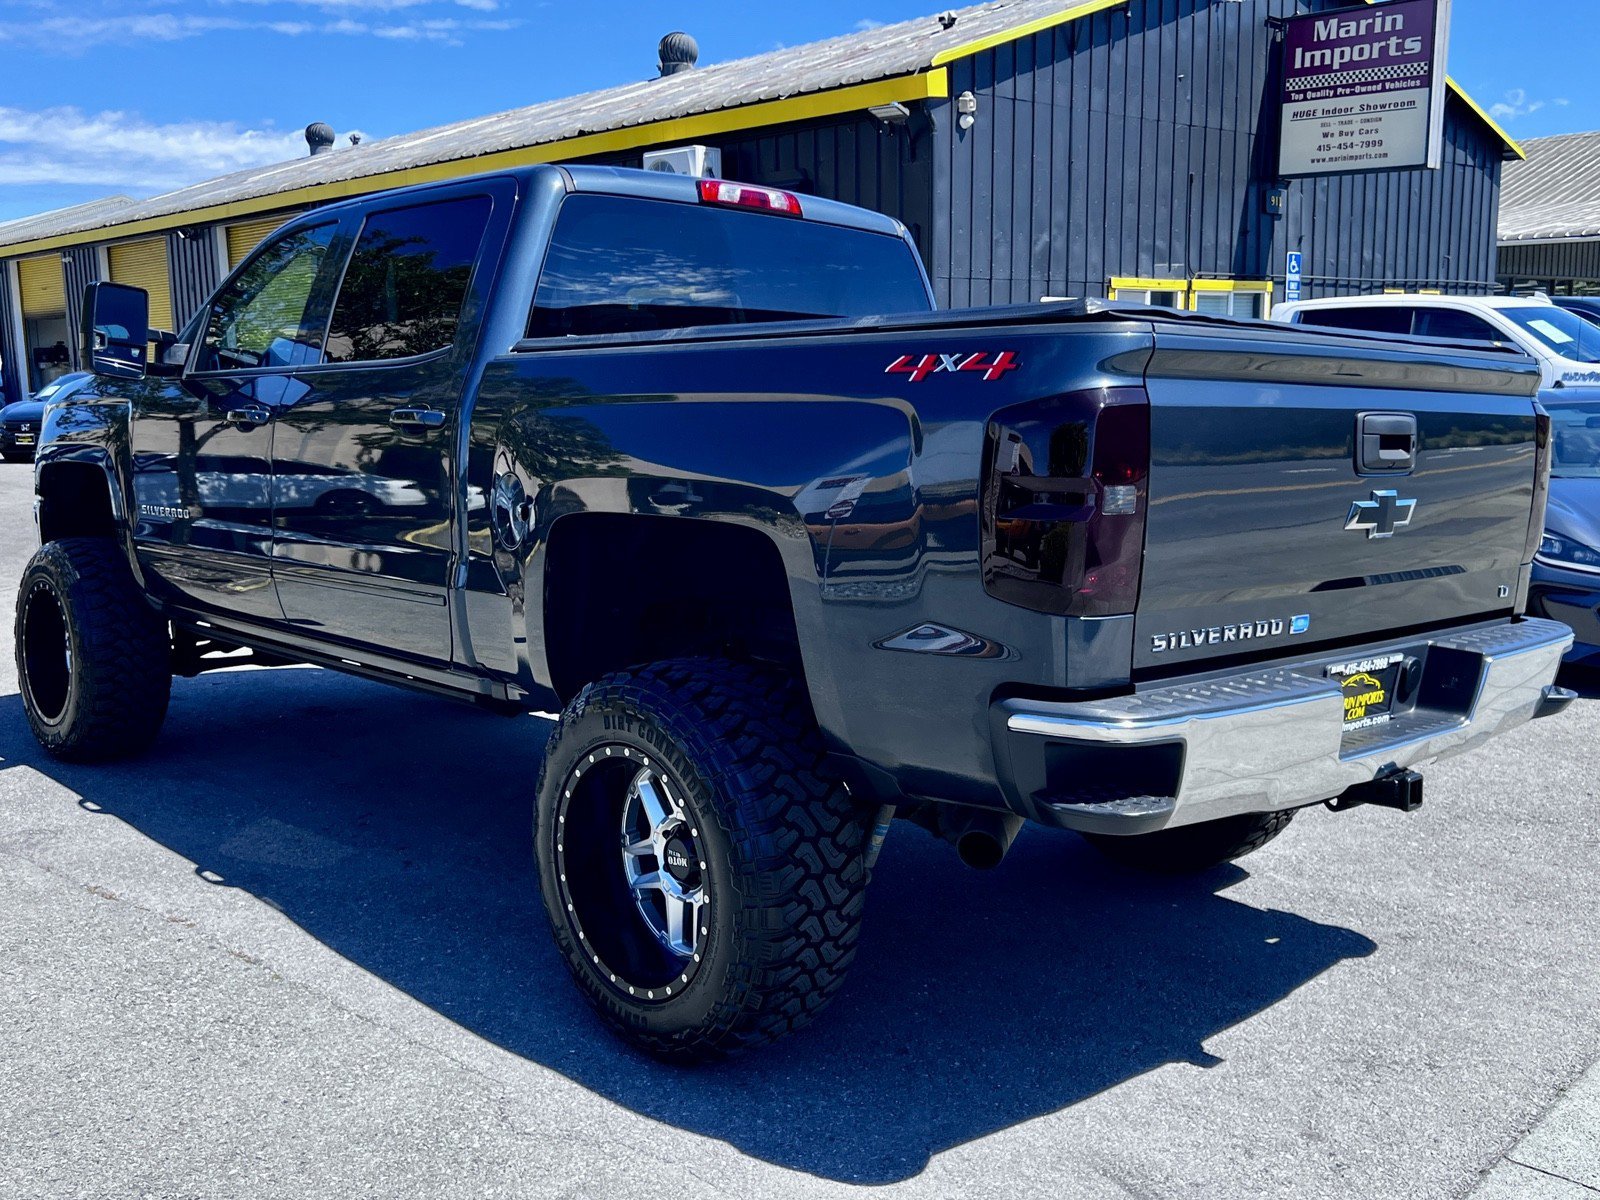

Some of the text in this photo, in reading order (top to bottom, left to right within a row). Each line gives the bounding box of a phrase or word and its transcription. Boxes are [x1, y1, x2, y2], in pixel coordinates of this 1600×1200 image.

[1313, 11, 1404, 42] Marin
[1294, 36, 1422, 69] Imports
[1291, 79, 1421, 101] Top Quality Pre-Owned Vehicles
[1292, 100, 1416, 119] HUGE Indoor Showroom
[1338, 130, 1355, 138] Buy
[1358, 128, 1379, 136] Cars
[1316, 139, 1383, 152] 415-454-7999
[1310, 152, 1389, 164] www.marinimports.com
[141, 504, 190, 519] SILVERADO
[1151, 618, 1284, 653] SILVERADO
[603, 714, 633, 733] DIRT
[668, 856, 688, 867] MOTO
